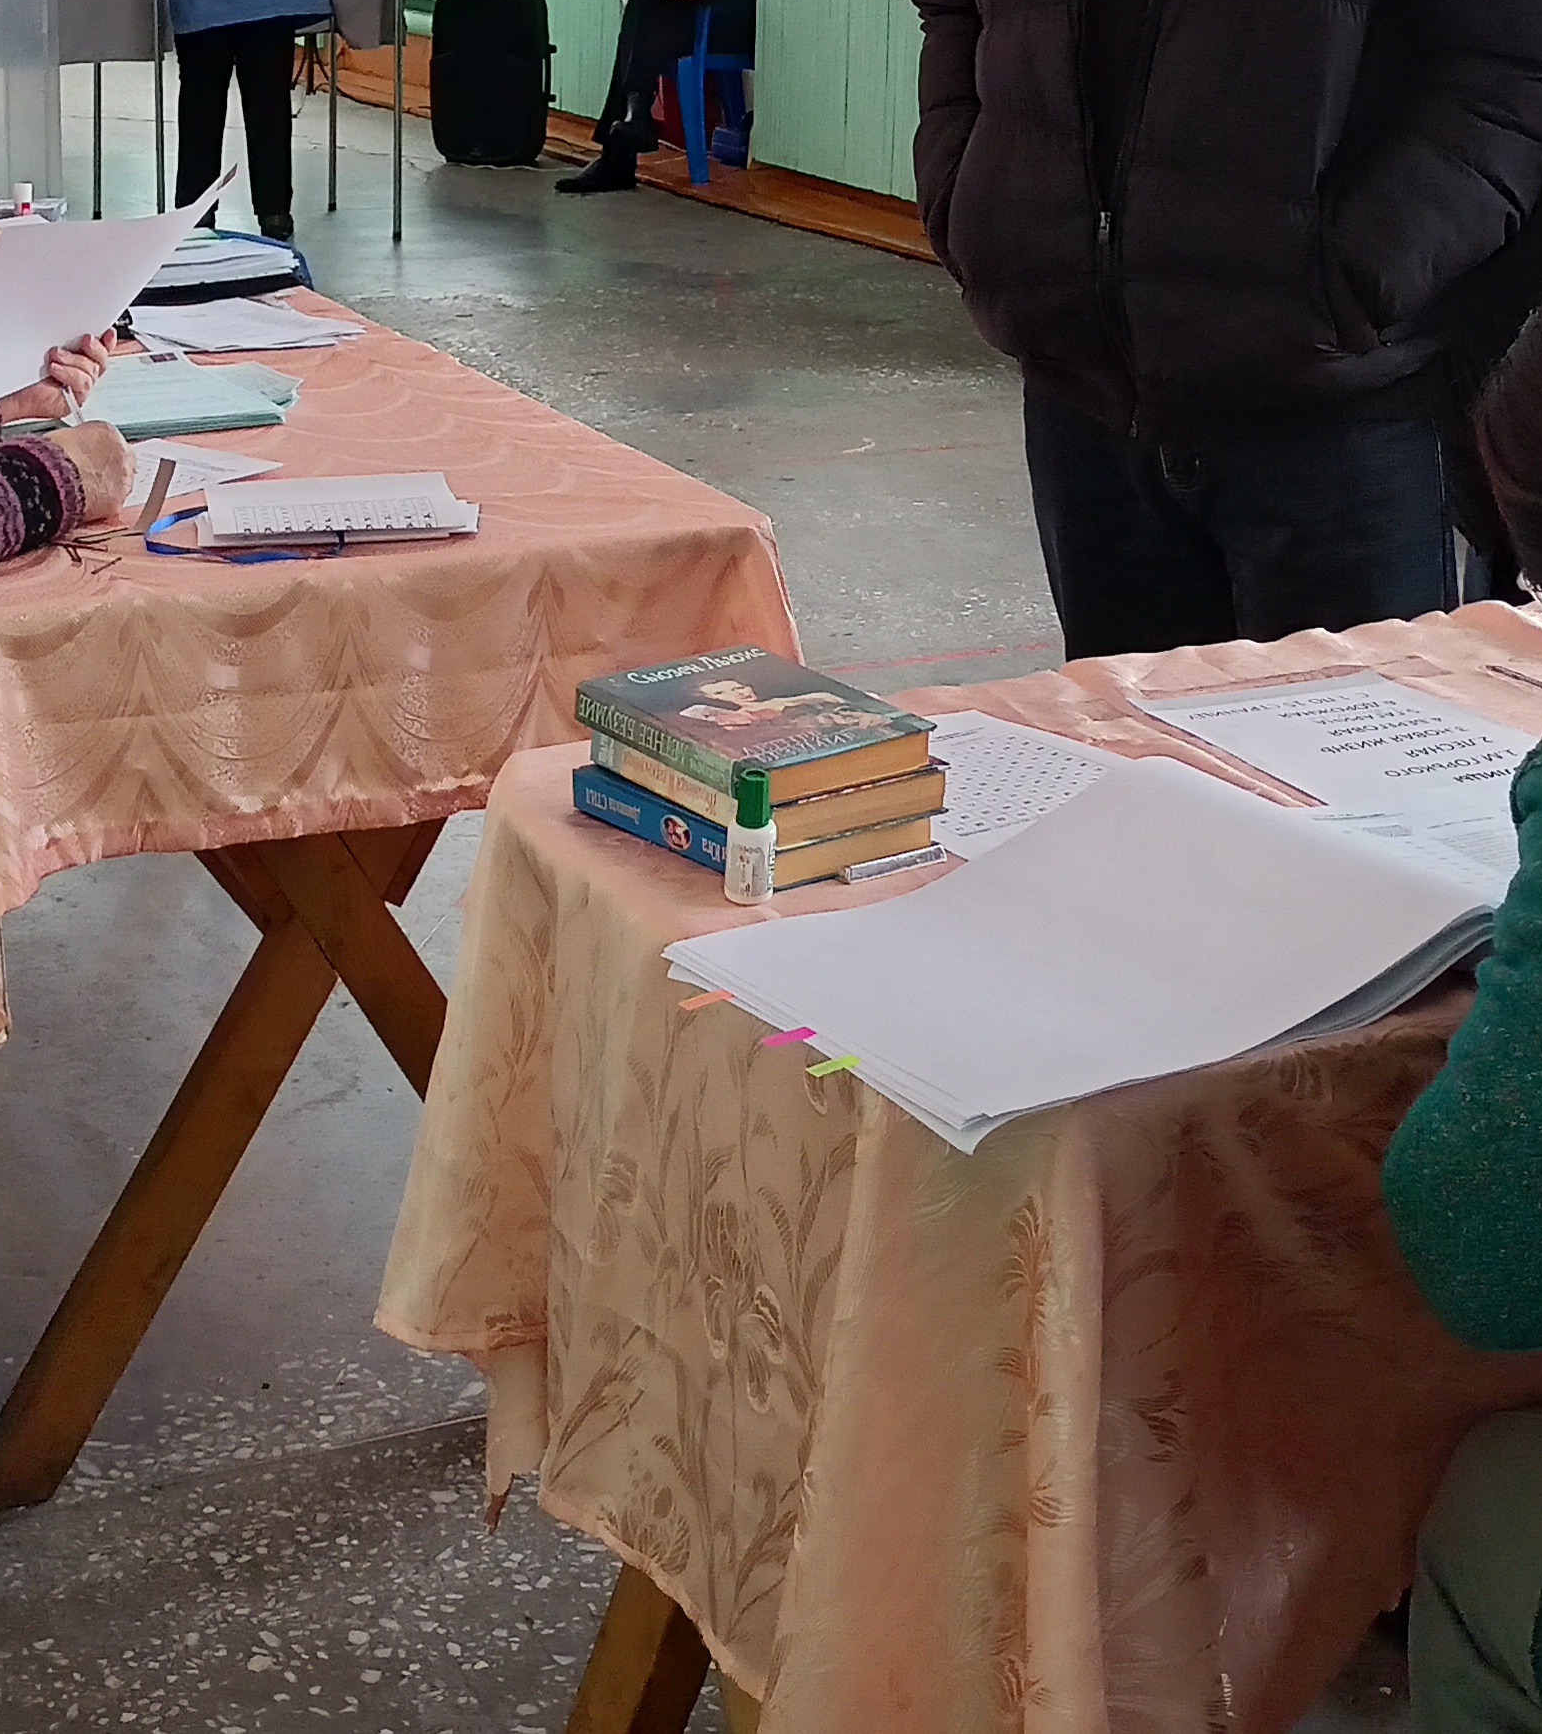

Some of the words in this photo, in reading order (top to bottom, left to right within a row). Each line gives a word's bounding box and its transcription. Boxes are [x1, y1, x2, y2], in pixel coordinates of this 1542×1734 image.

[627, 662, 703, 686] Сьюзен
[705, 646, 767, 671] Льюис
[579, 694, 636, 741] БЕЗУМИЕ
[1320, 737, 1388, 754] ЖИЗНЬ
[1452, 767, 1517, 783] ЛИЦЫ
